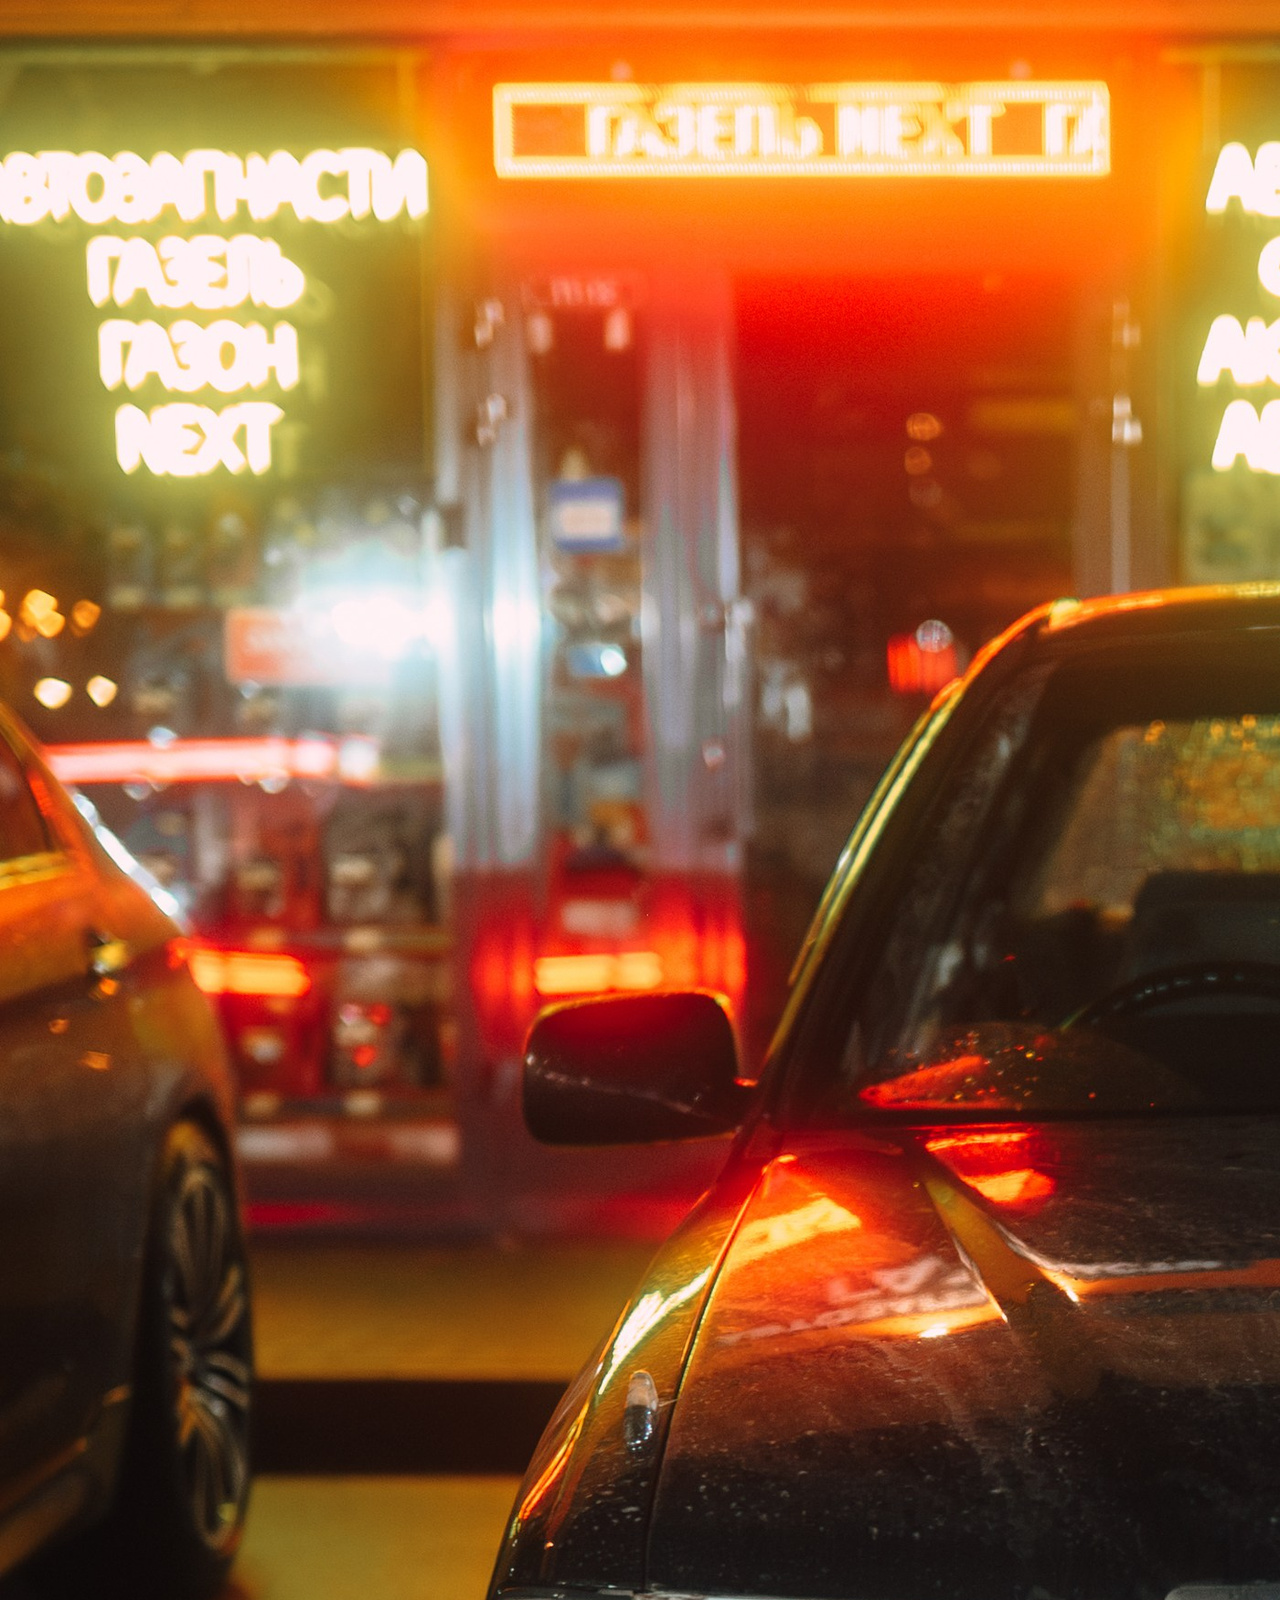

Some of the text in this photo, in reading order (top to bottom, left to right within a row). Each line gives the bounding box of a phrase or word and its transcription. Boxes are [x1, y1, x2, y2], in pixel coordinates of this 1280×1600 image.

[835, 100, 1005, 158] NEXT
[87, 235, 305, 309] ГАЗЕЛЬ
[99, 319, 299, 392] ГАЗОН
[115, 402, 284, 476] NEXT
